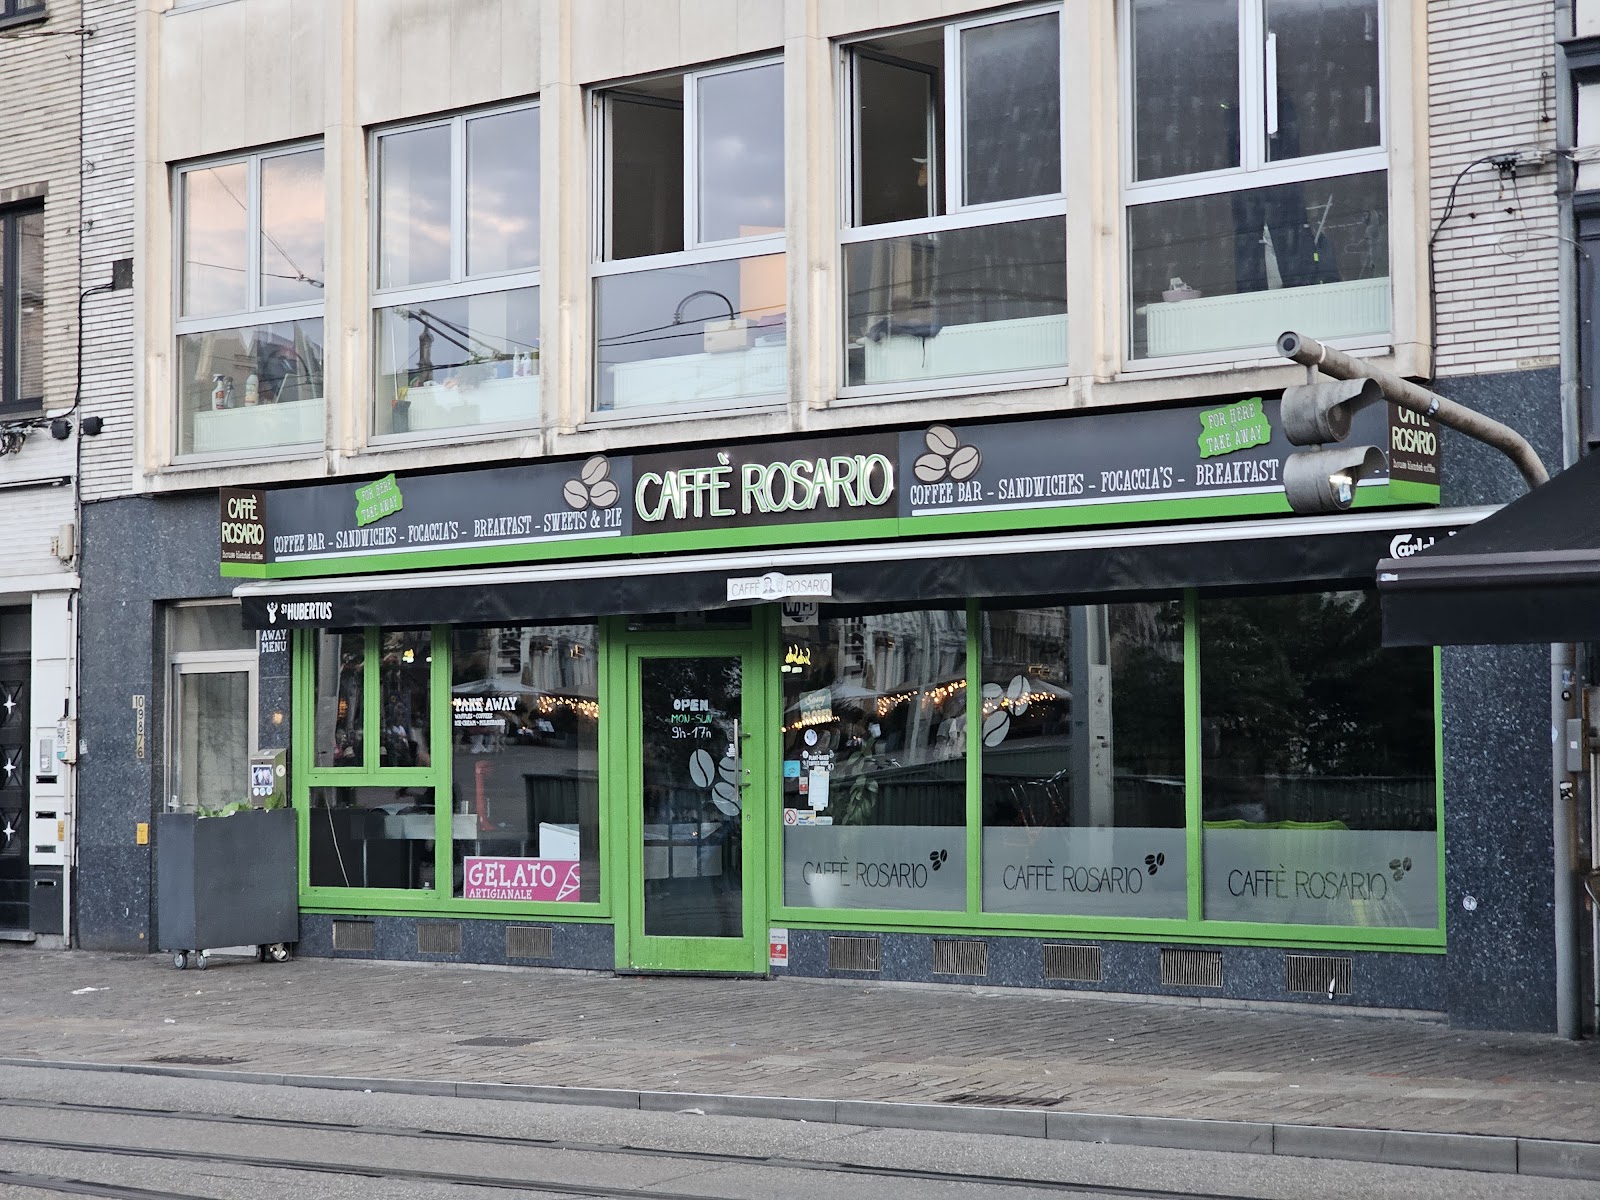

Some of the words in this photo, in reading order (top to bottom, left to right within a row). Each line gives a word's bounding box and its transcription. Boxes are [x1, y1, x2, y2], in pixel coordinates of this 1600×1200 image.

[1207, 412, 1226, 429] FOR
[1229, 403, 1256, 423] HERE
[1206, 433, 1232, 452] TAKE
[1235, 424, 1262, 445] AWAY
[1391, 426, 1437, 456] ROSARIO
[635, 451, 736, 522] CAFFÈ
[742, 453, 895, 515] ROSARIO
[910, 482, 953, 505] COFFEE
[957, 480, 982, 502] BAR
[998, 473, 1084, 499] SANDWICHES
[1100, 466, 1173, 492] FOCACCIA'S
[1196, 458, 1279, 486] BREAKFAST
[227, 494, 258, 520] CAFFÈ
[221, 522, 265, 545] ROSARIO
[273, 533, 305, 553] COFFEE
[307, 532, 325, 551] BAR
[336, 527, 397, 549] SANDWICHES
[407, 521, 459, 543] FOCACCIA'S
[473, 515, 532, 538] BREAKFAST
[543, 510, 587, 533] SWEETS
[590, 510, 600, 528] &
[604, 508, 622, 527] PIE
[731, 579, 760, 597] CAFFÈ
[785, 578, 829, 593] ROSARIO
[287, 602, 332, 620] HUBERTUS
[261, 629, 287, 641] AWAY
[261, 641, 287, 653] MENU
[135, 696, 144, 707] 10
[454, 697, 483, 712] TAKE
[484, 697, 518, 711] AWAY
[673, 699, 709, 711] OPEN
[138, 708, 144, 720] 9
[138, 721, 144, 732] 8
[671, 726, 712, 739] 9h-17h
[138, 733, 144, 745] 7
[138, 746, 144, 757] 6
[468, 861, 556, 887] GELATO
[856, 862, 928, 889] ROSARIO
[1003, 858, 1056, 891] CAFFÈ
[1063, 866, 1143, 894] ROSARIO
[1228, 863, 1288, 898] CAFFÈ
[1295, 871, 1388, 900] ROSARIO
[468, 888, 533, 900] ARTIGIANALE
